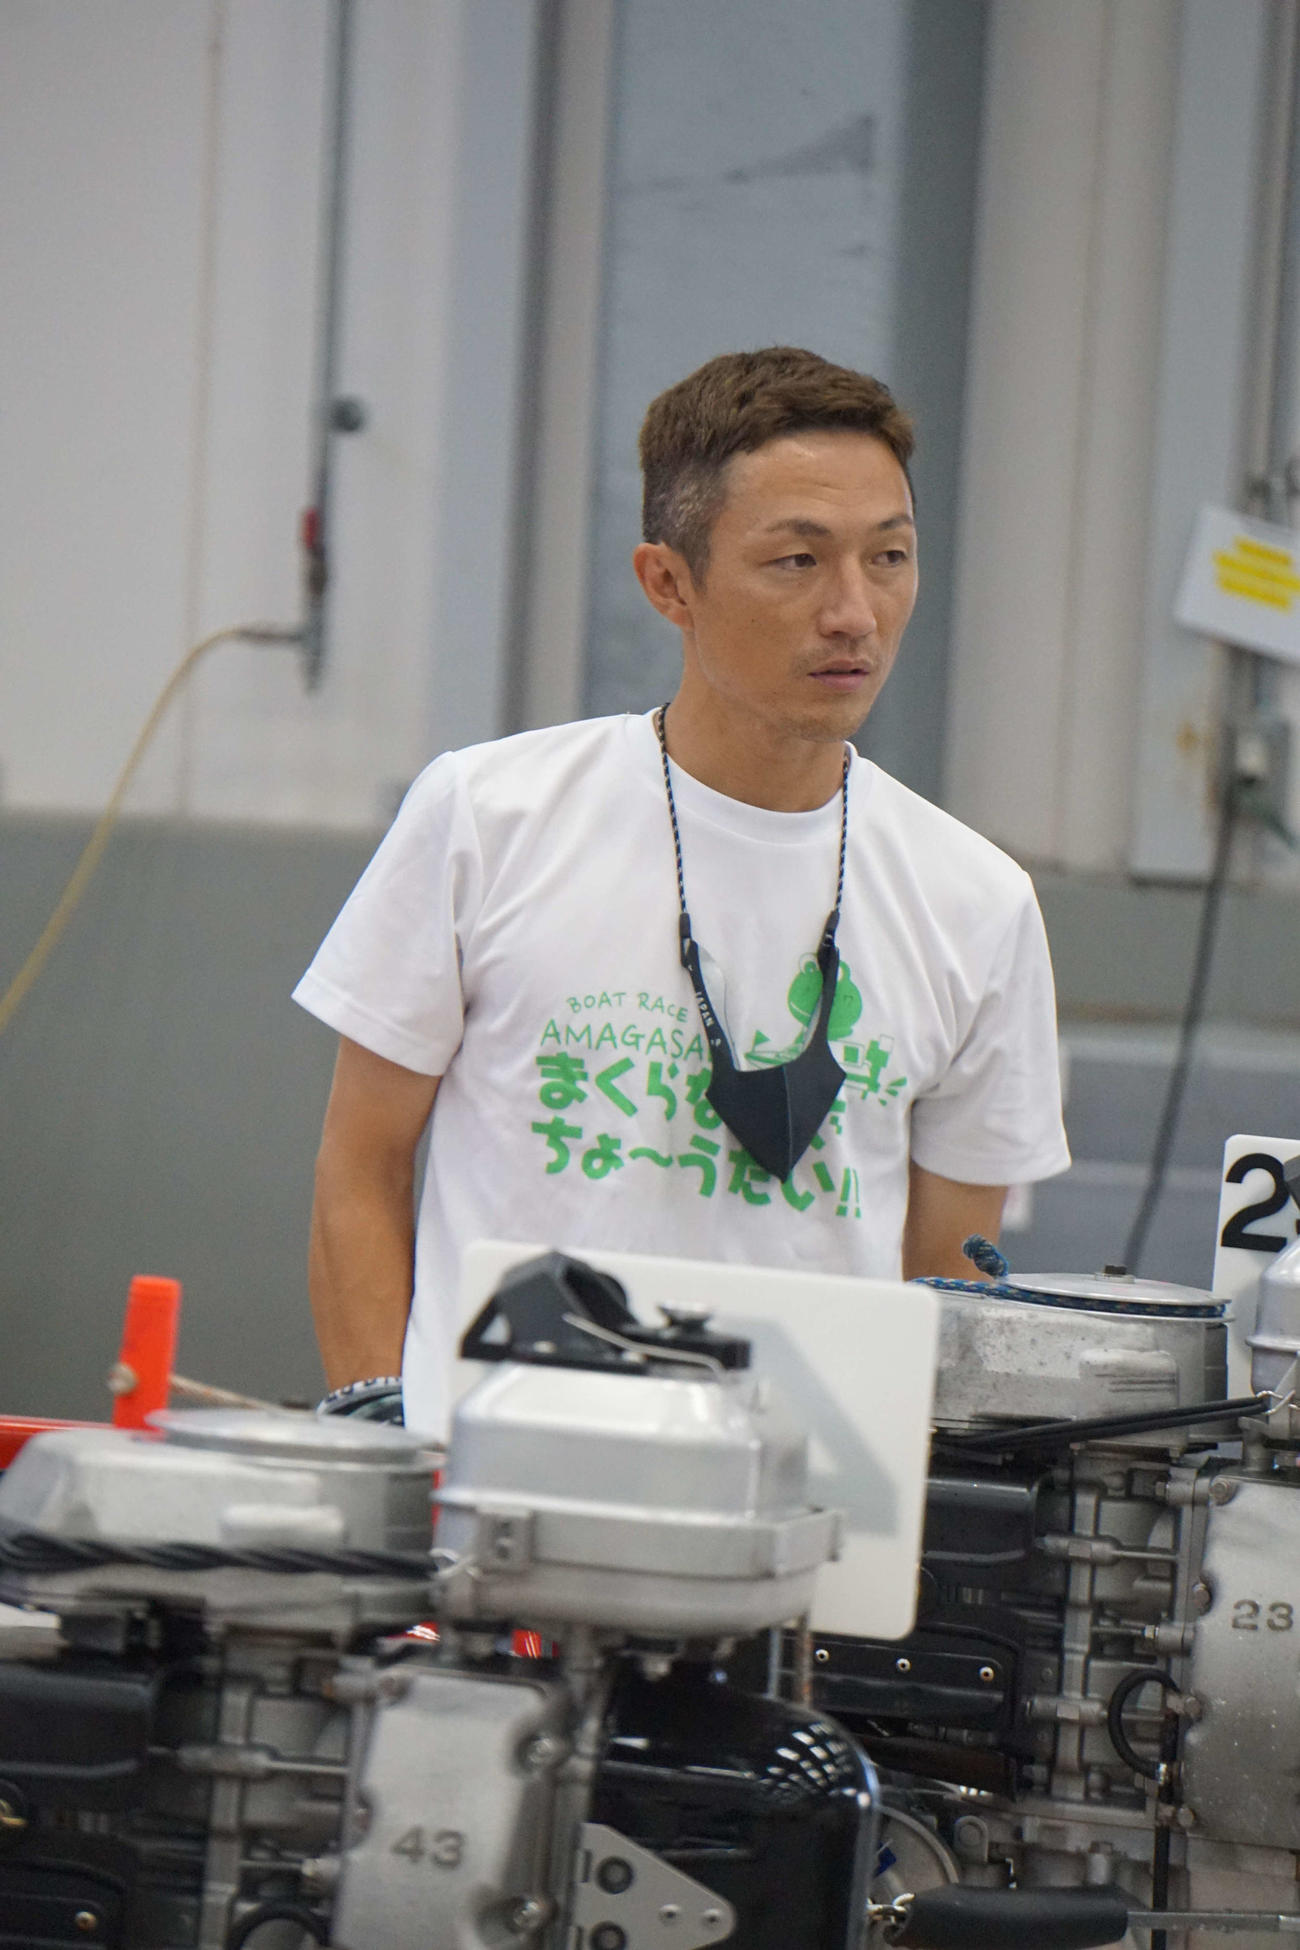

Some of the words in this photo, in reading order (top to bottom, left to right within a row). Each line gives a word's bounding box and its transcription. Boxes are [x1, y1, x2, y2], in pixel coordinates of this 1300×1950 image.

[567, 991, 626, 1013] BOAT
[637, 992, 688, 1023] RACE
[540, 1018, 712, 1063] AMAGASA
[1221, 1152, 1300, 1253] 2
[1231, 1599, 1294, 1633] 23
[390, 1826, 466, 1871] 43
